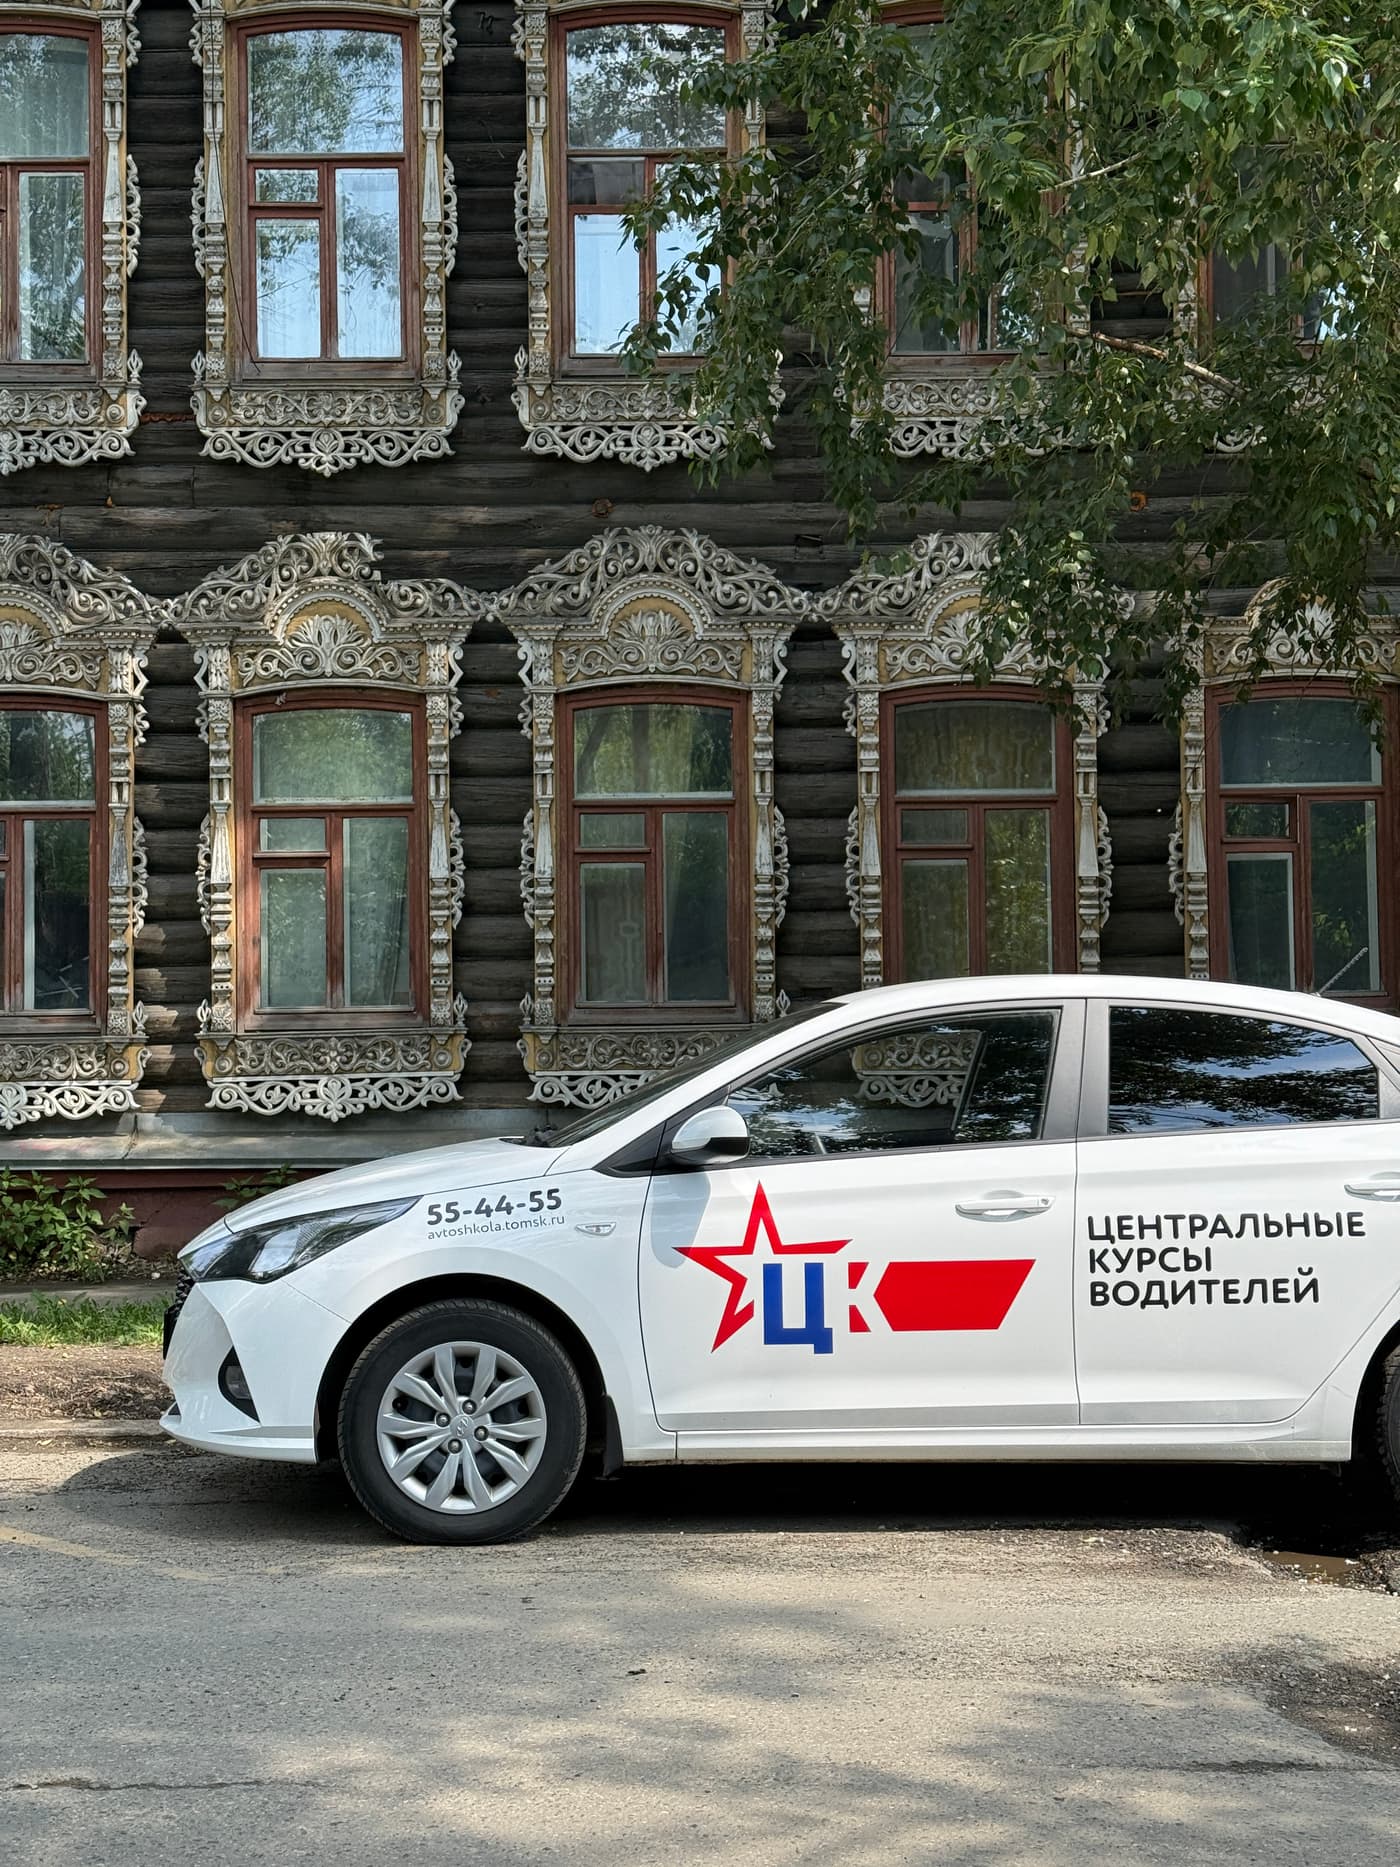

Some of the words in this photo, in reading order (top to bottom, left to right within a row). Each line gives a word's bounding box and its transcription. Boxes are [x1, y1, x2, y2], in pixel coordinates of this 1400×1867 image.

[426, 1188, 562, 1226] 55-44-55
[427, 1214, 565, 1240] avtoshkola.tomsk.ru
[1087, 1211, 1367, 1244] ЦЕНТРАЛЬНЫЕ
[1089, 1246, 1212, 1274] КУРСЫ
[1089, 1266, 1320, 1310] ВОДИТЕЛЕЙ
[763, 1262, 891, 1354] ЦК
